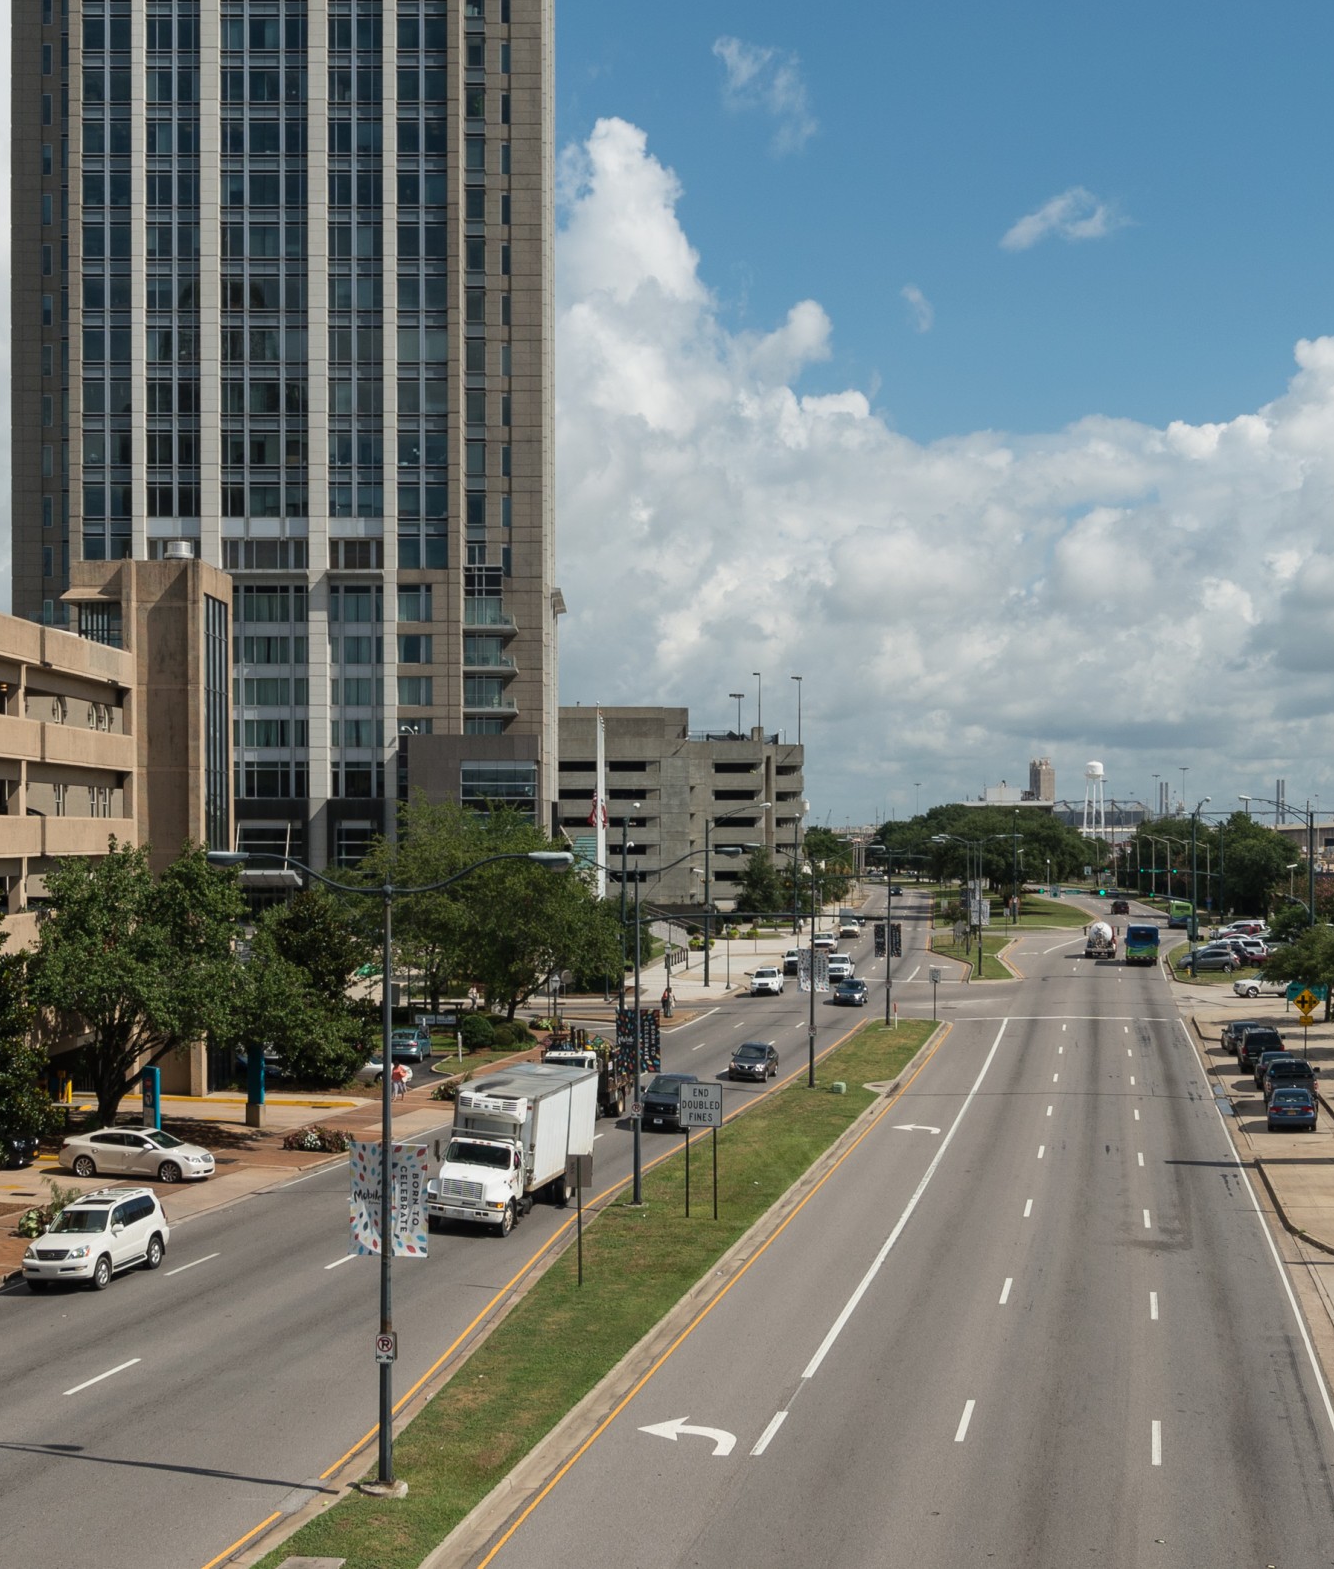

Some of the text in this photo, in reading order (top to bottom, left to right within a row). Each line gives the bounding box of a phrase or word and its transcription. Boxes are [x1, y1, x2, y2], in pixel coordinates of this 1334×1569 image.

[692, 1088, 709, 1098] END
[682, 1100, 720, 1110] DOUBLED
[688, 1113, 713, 1122] FINES
[353, 1188, 383, 1203] Mobile
[400, 1165, 408, 1233] CELEBRATE
[412, 1210, 419, 1226] TO
